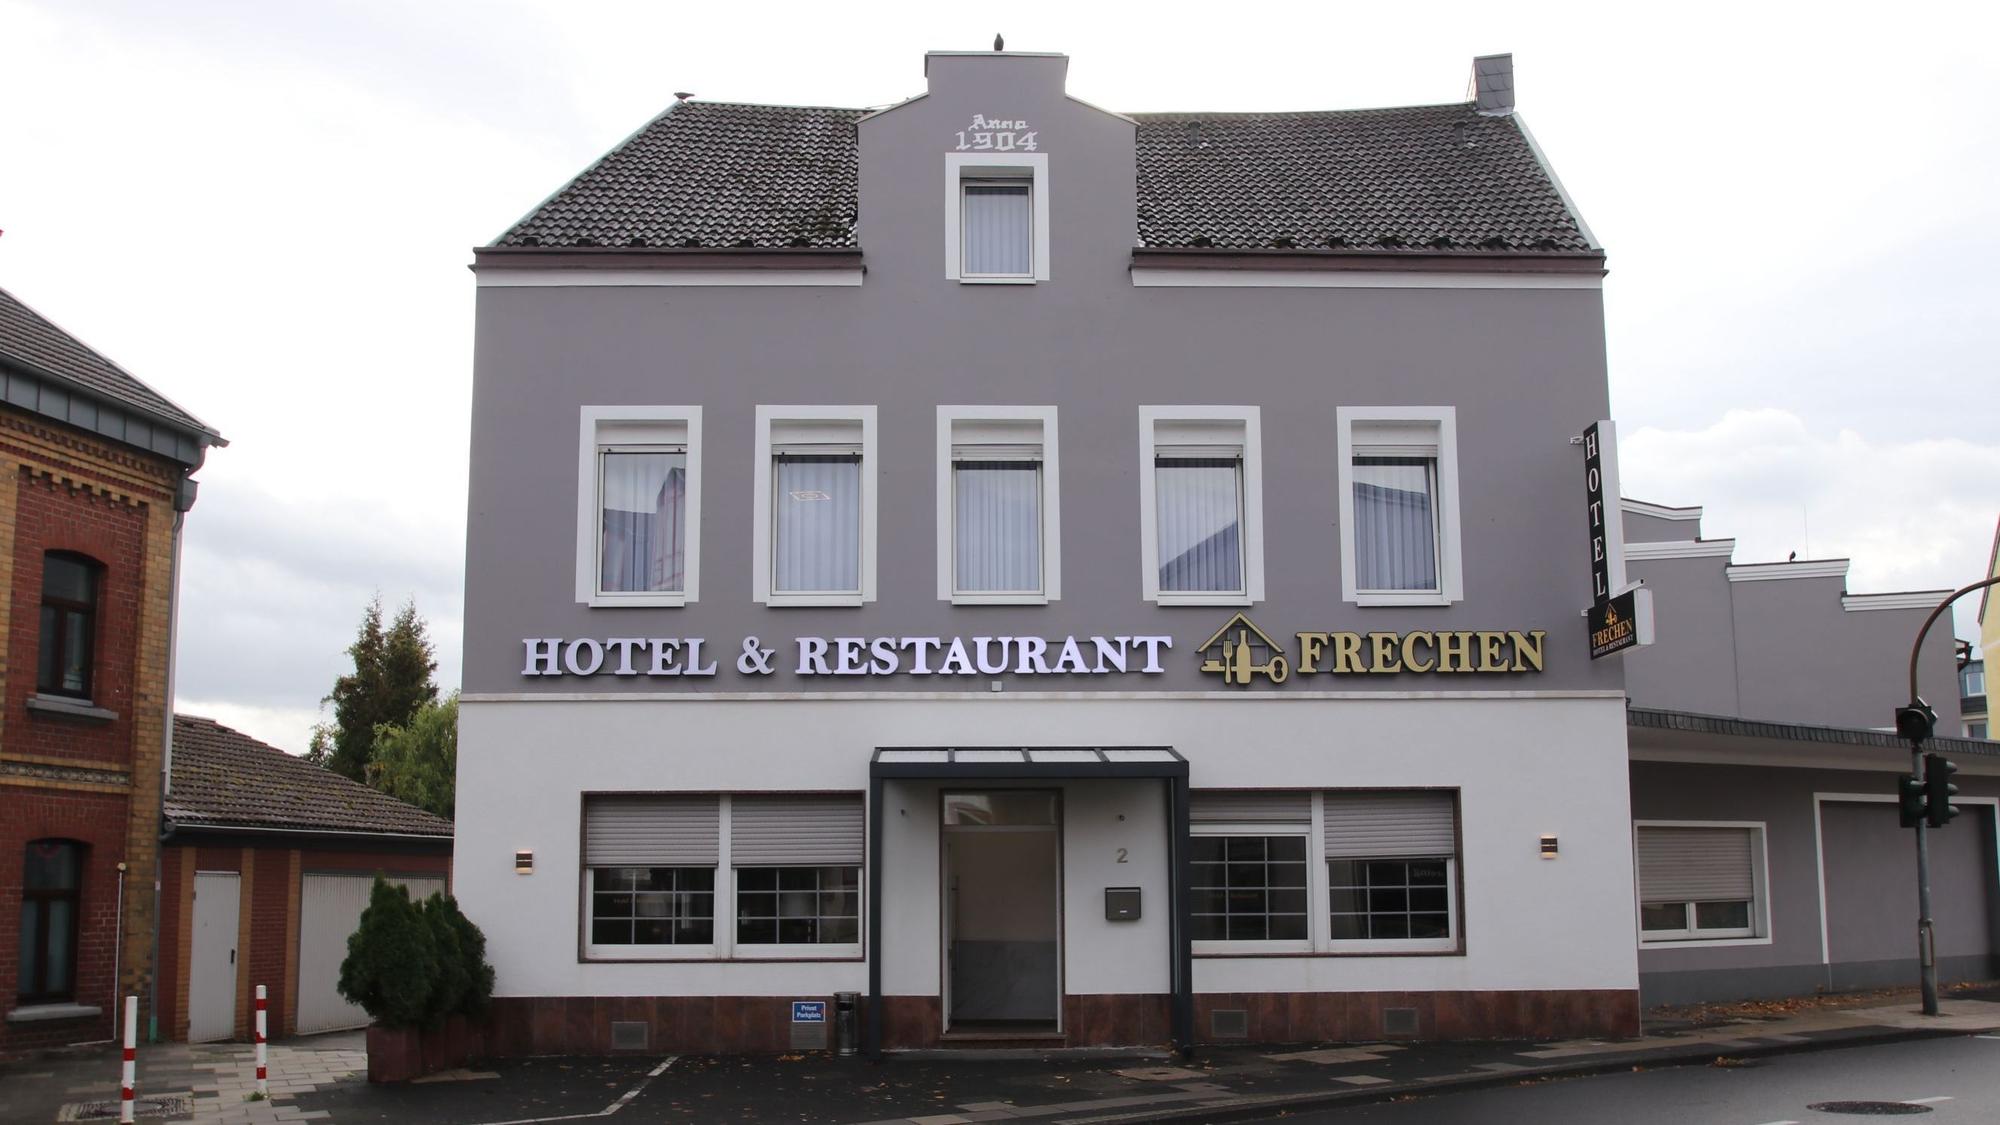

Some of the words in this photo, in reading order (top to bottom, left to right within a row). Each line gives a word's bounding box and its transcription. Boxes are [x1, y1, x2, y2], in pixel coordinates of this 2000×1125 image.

[955, 131, 1038, 151] 1904
[1586, 431, 1606, 597] HOTEL
[1593, 618, 1633, 648] FRECHEN
[521, 637, 717, 676] HOTEL
[737, 636, 775, 675] &
[795, 635, 1173, 675] RESTAURANT
[1295, 630, 1546, 673] FRECHEN
[1116, 847, 1128, 863] 2
